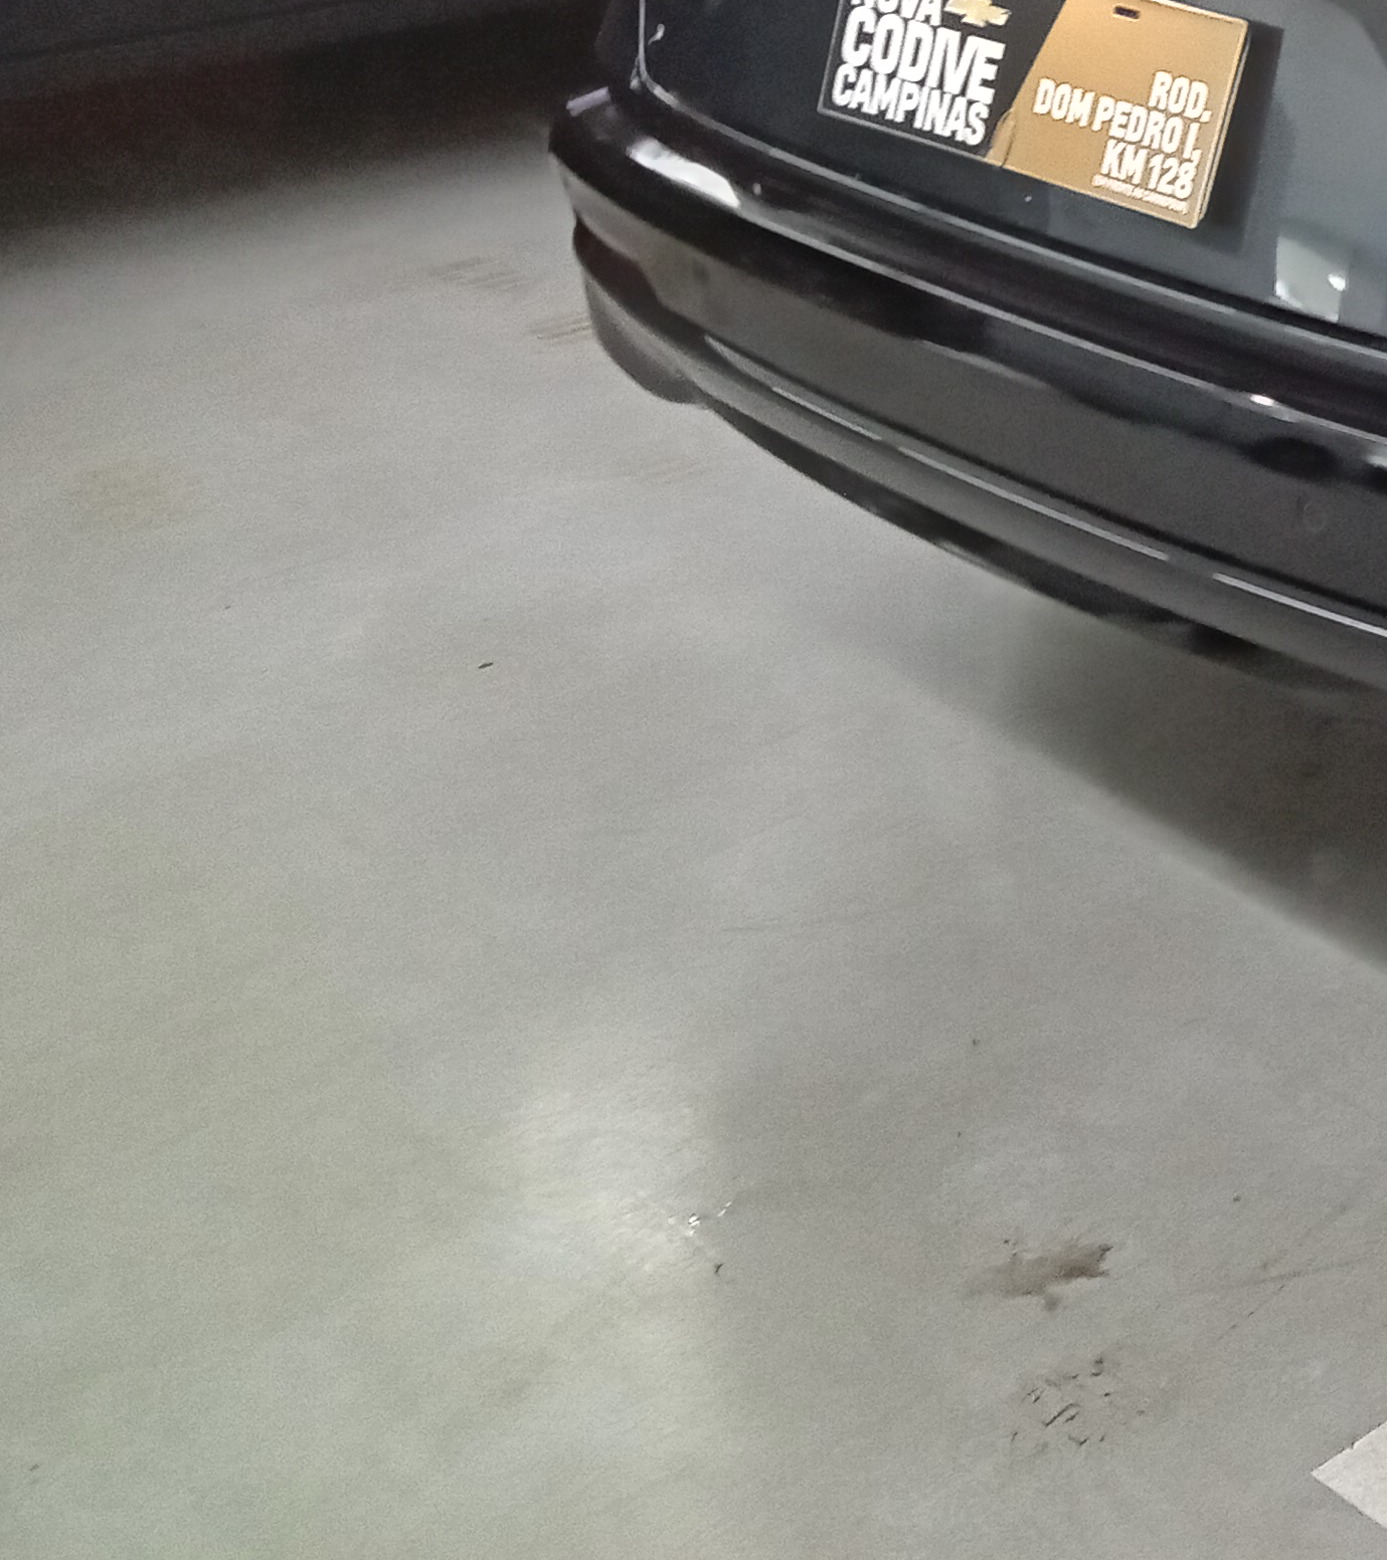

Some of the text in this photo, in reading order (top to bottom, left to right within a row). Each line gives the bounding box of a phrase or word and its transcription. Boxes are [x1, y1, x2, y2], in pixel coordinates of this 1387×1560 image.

[841, 5, 1006, 105] CODIVE
[831, 62, 990, 146] CAMPINAS
[1032, 77, 1096, 127] DOM
[1091, 95, 1184, 155] PEDRO
[1148, 70, 1213, 123] ROD.
[1100, 138, 1149, 185] KM
[1147, 153, 1199, 200] 128
